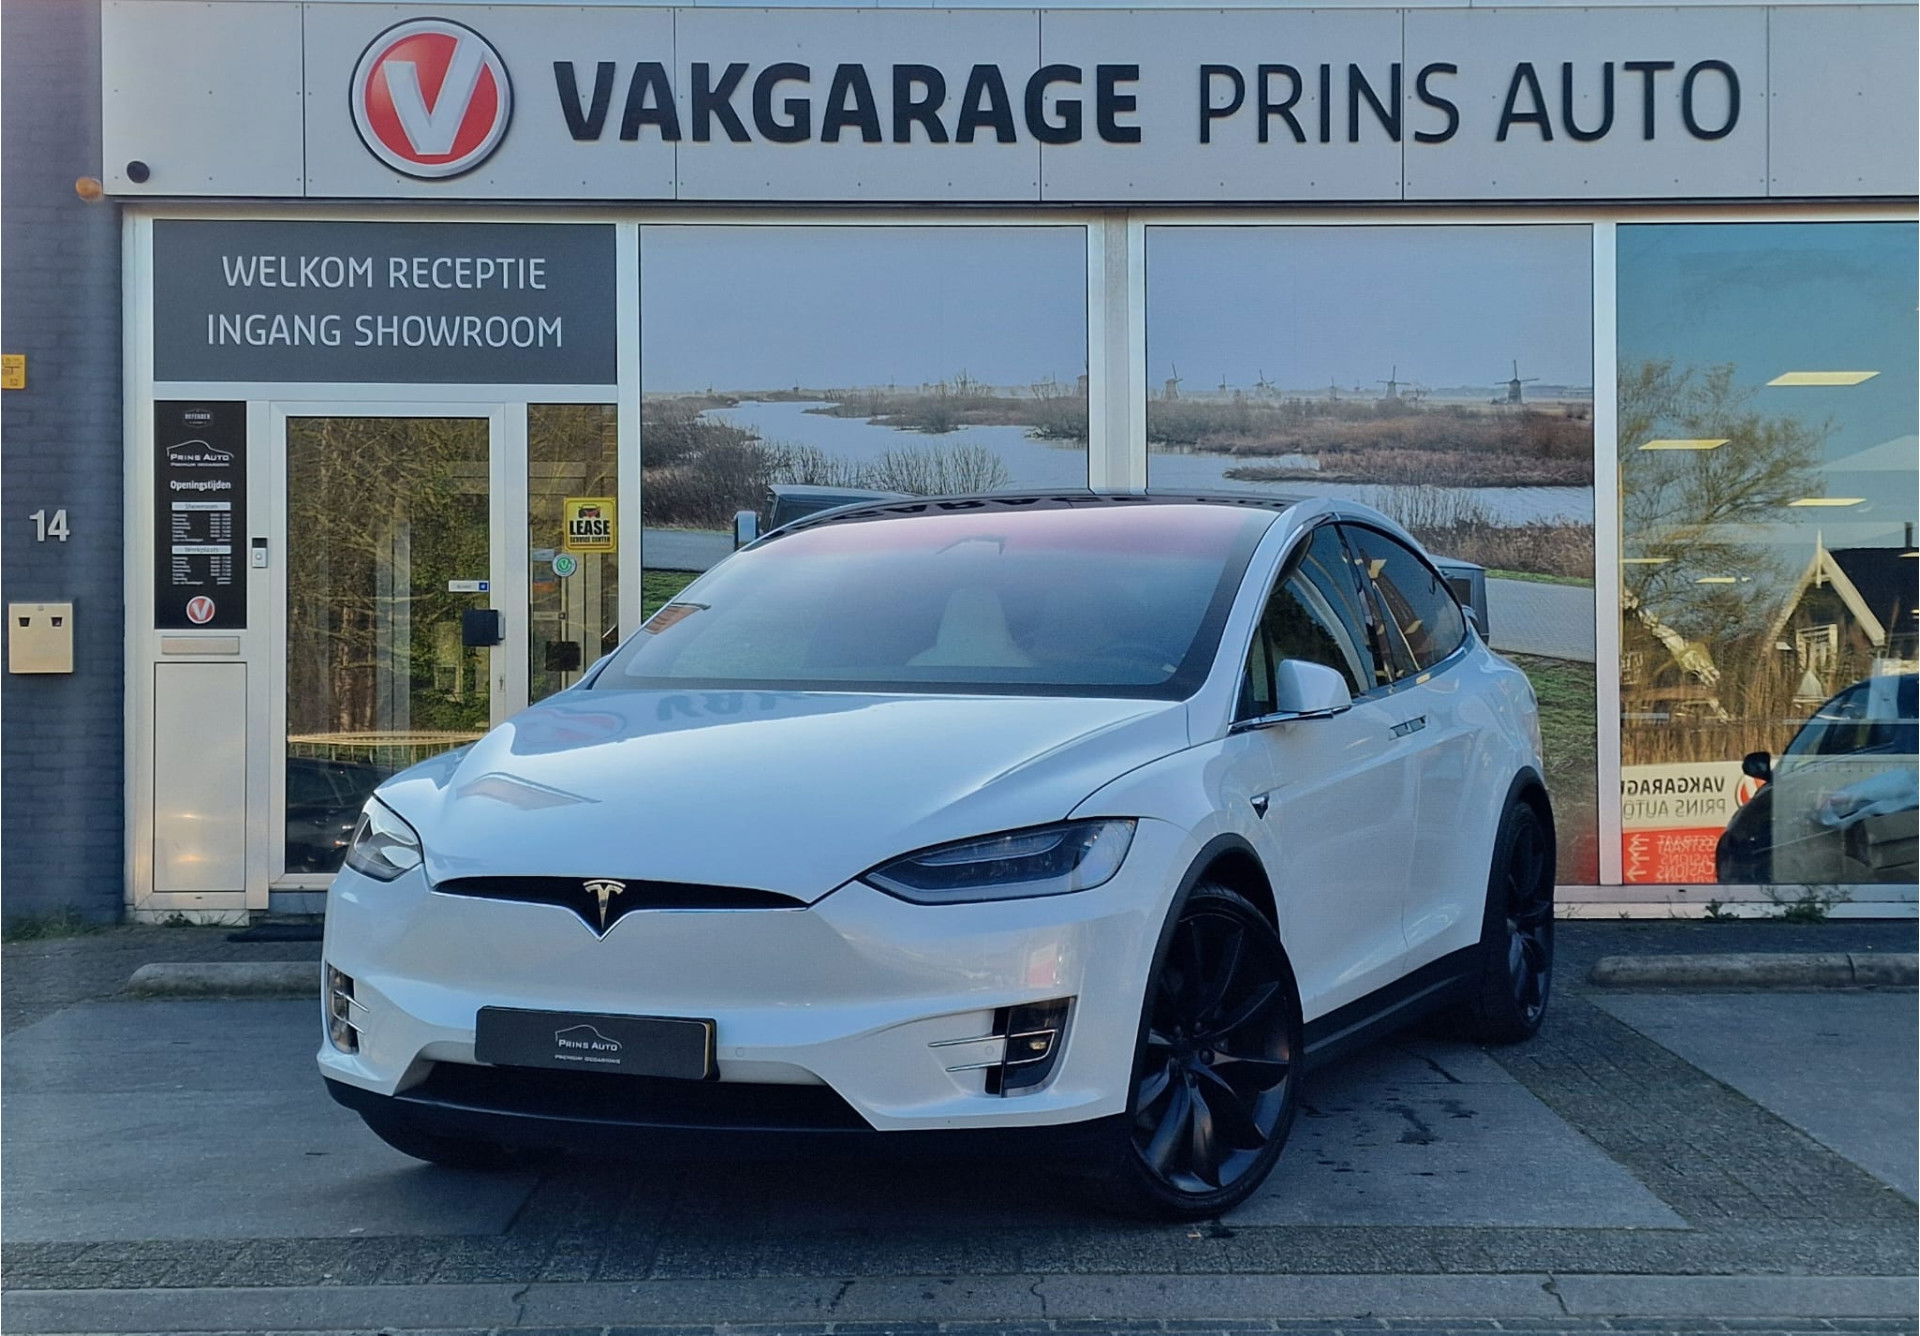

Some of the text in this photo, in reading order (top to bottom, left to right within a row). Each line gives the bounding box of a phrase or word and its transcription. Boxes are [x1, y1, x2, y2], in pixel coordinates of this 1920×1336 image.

[554, 59, 1741, 144] VAKGARAGE PRINS AUTO
[222, 255, 547, 290] WELKOM RECEPTIE
[208, 312, 563, 348] INGANG SHOWROOM
[203, 453, 230, 461] AUTO
[170, 480, 231, 491] Openingstijden
[29, 509, 70, 541] 14
[569, 520, 610, 535] LEASE
[558, 1039, 618, 1051] PRINS AUTO
